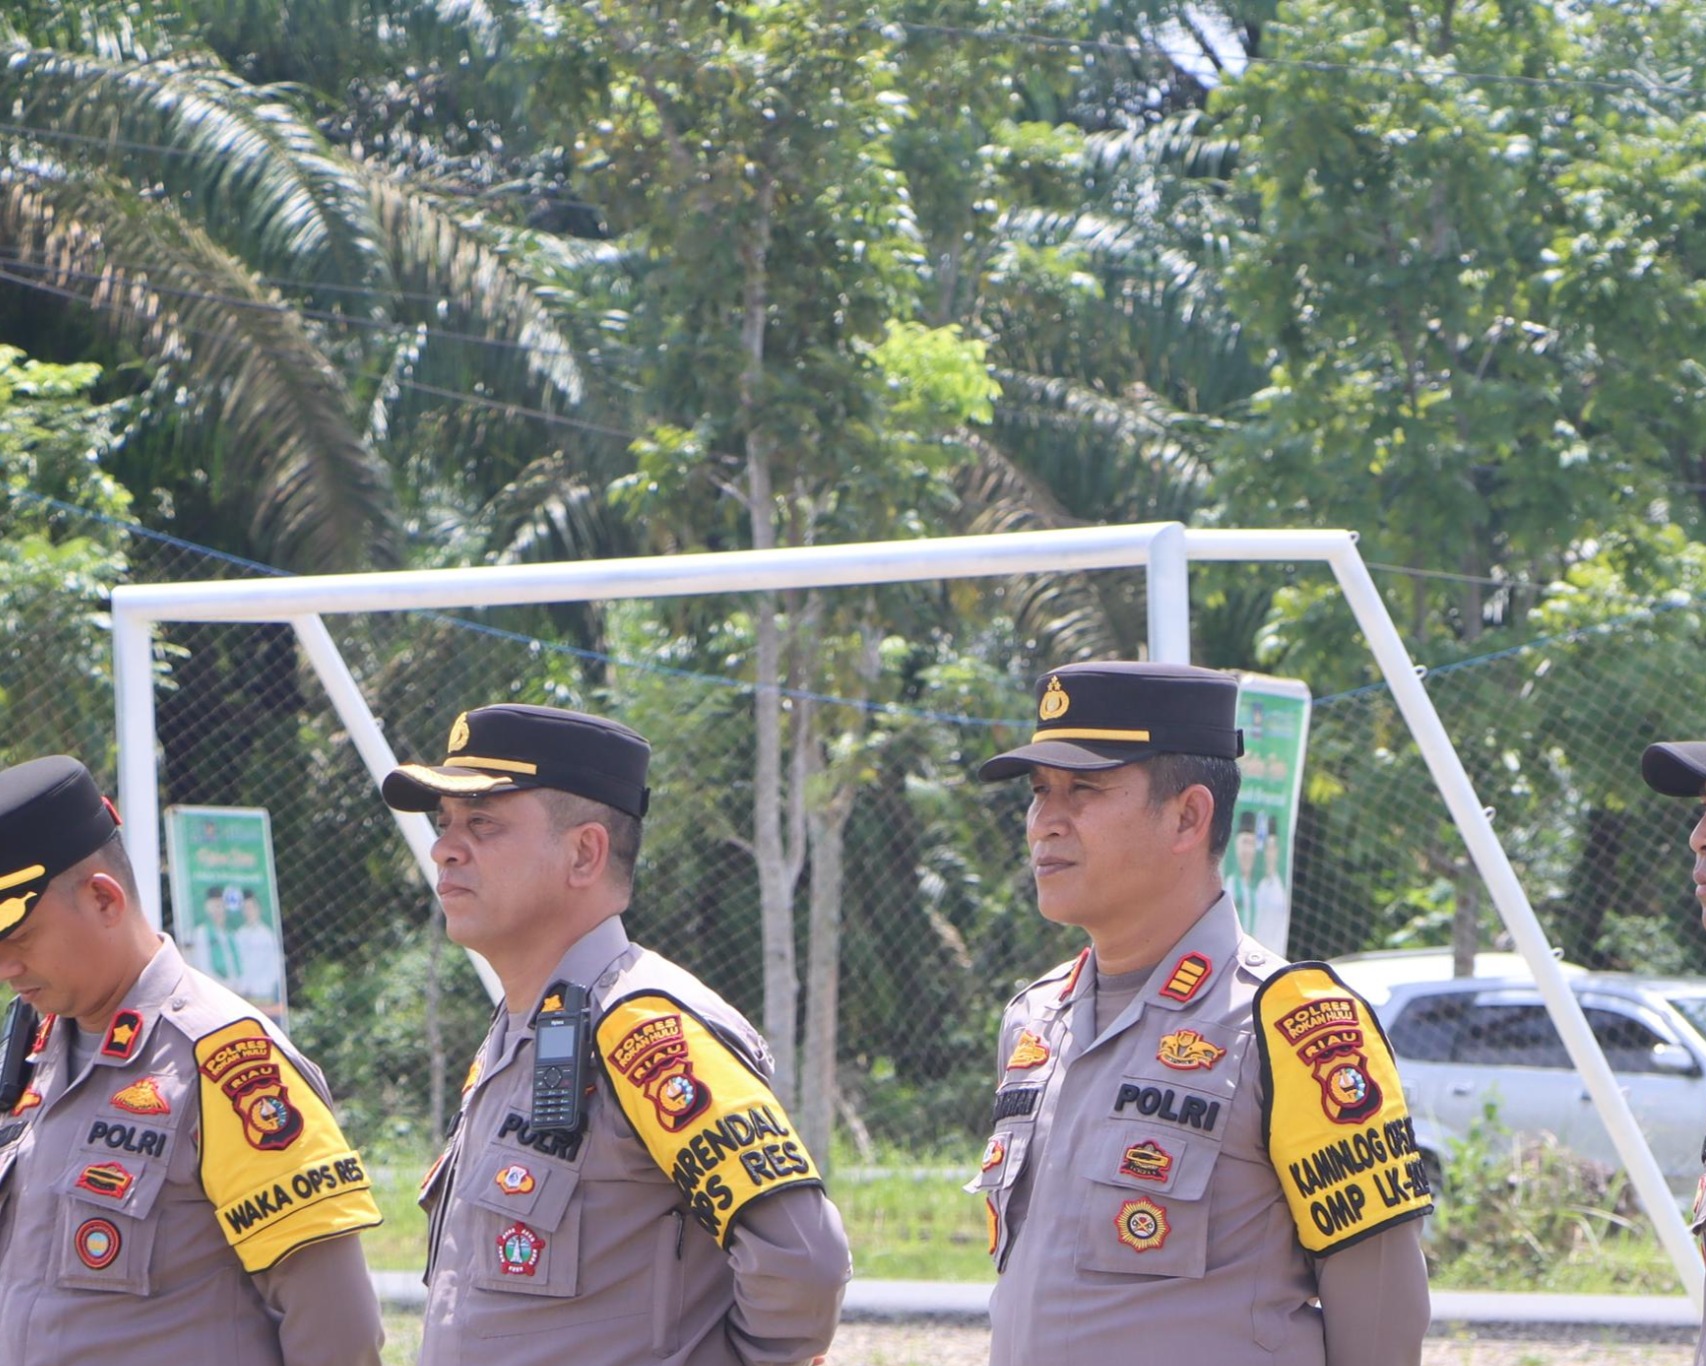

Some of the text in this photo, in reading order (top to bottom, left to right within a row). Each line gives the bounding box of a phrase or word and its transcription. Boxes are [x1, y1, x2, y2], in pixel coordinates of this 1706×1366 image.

[1284, 1001, 1350, 1028] POLRES
[1289, 1009, 1353, 1038] ROKAN HULU
[206, 1039, 267, 1070] POLRES
[615, 1017, 677, 1060] POLRES
[620, 1026, 679, 1068] ROKAN HULU
[1305, 1032, 1357, 1058] RIAU
[230, 1066, 273, 1089] RIAU
[634, 1043, 682, 1079] RIAU
[1114, 1083, 1221, 1132] POLRI
[88, 1121, 167, 1158] POLRI
[740, 1141, 810, 1186] RES
[1289, 1127, 1387, 1199] KAMINLOG
[224, 1157, 365, 1235] WAKA OPS RES
[1310, 1183, 1366, 1237] OMP
